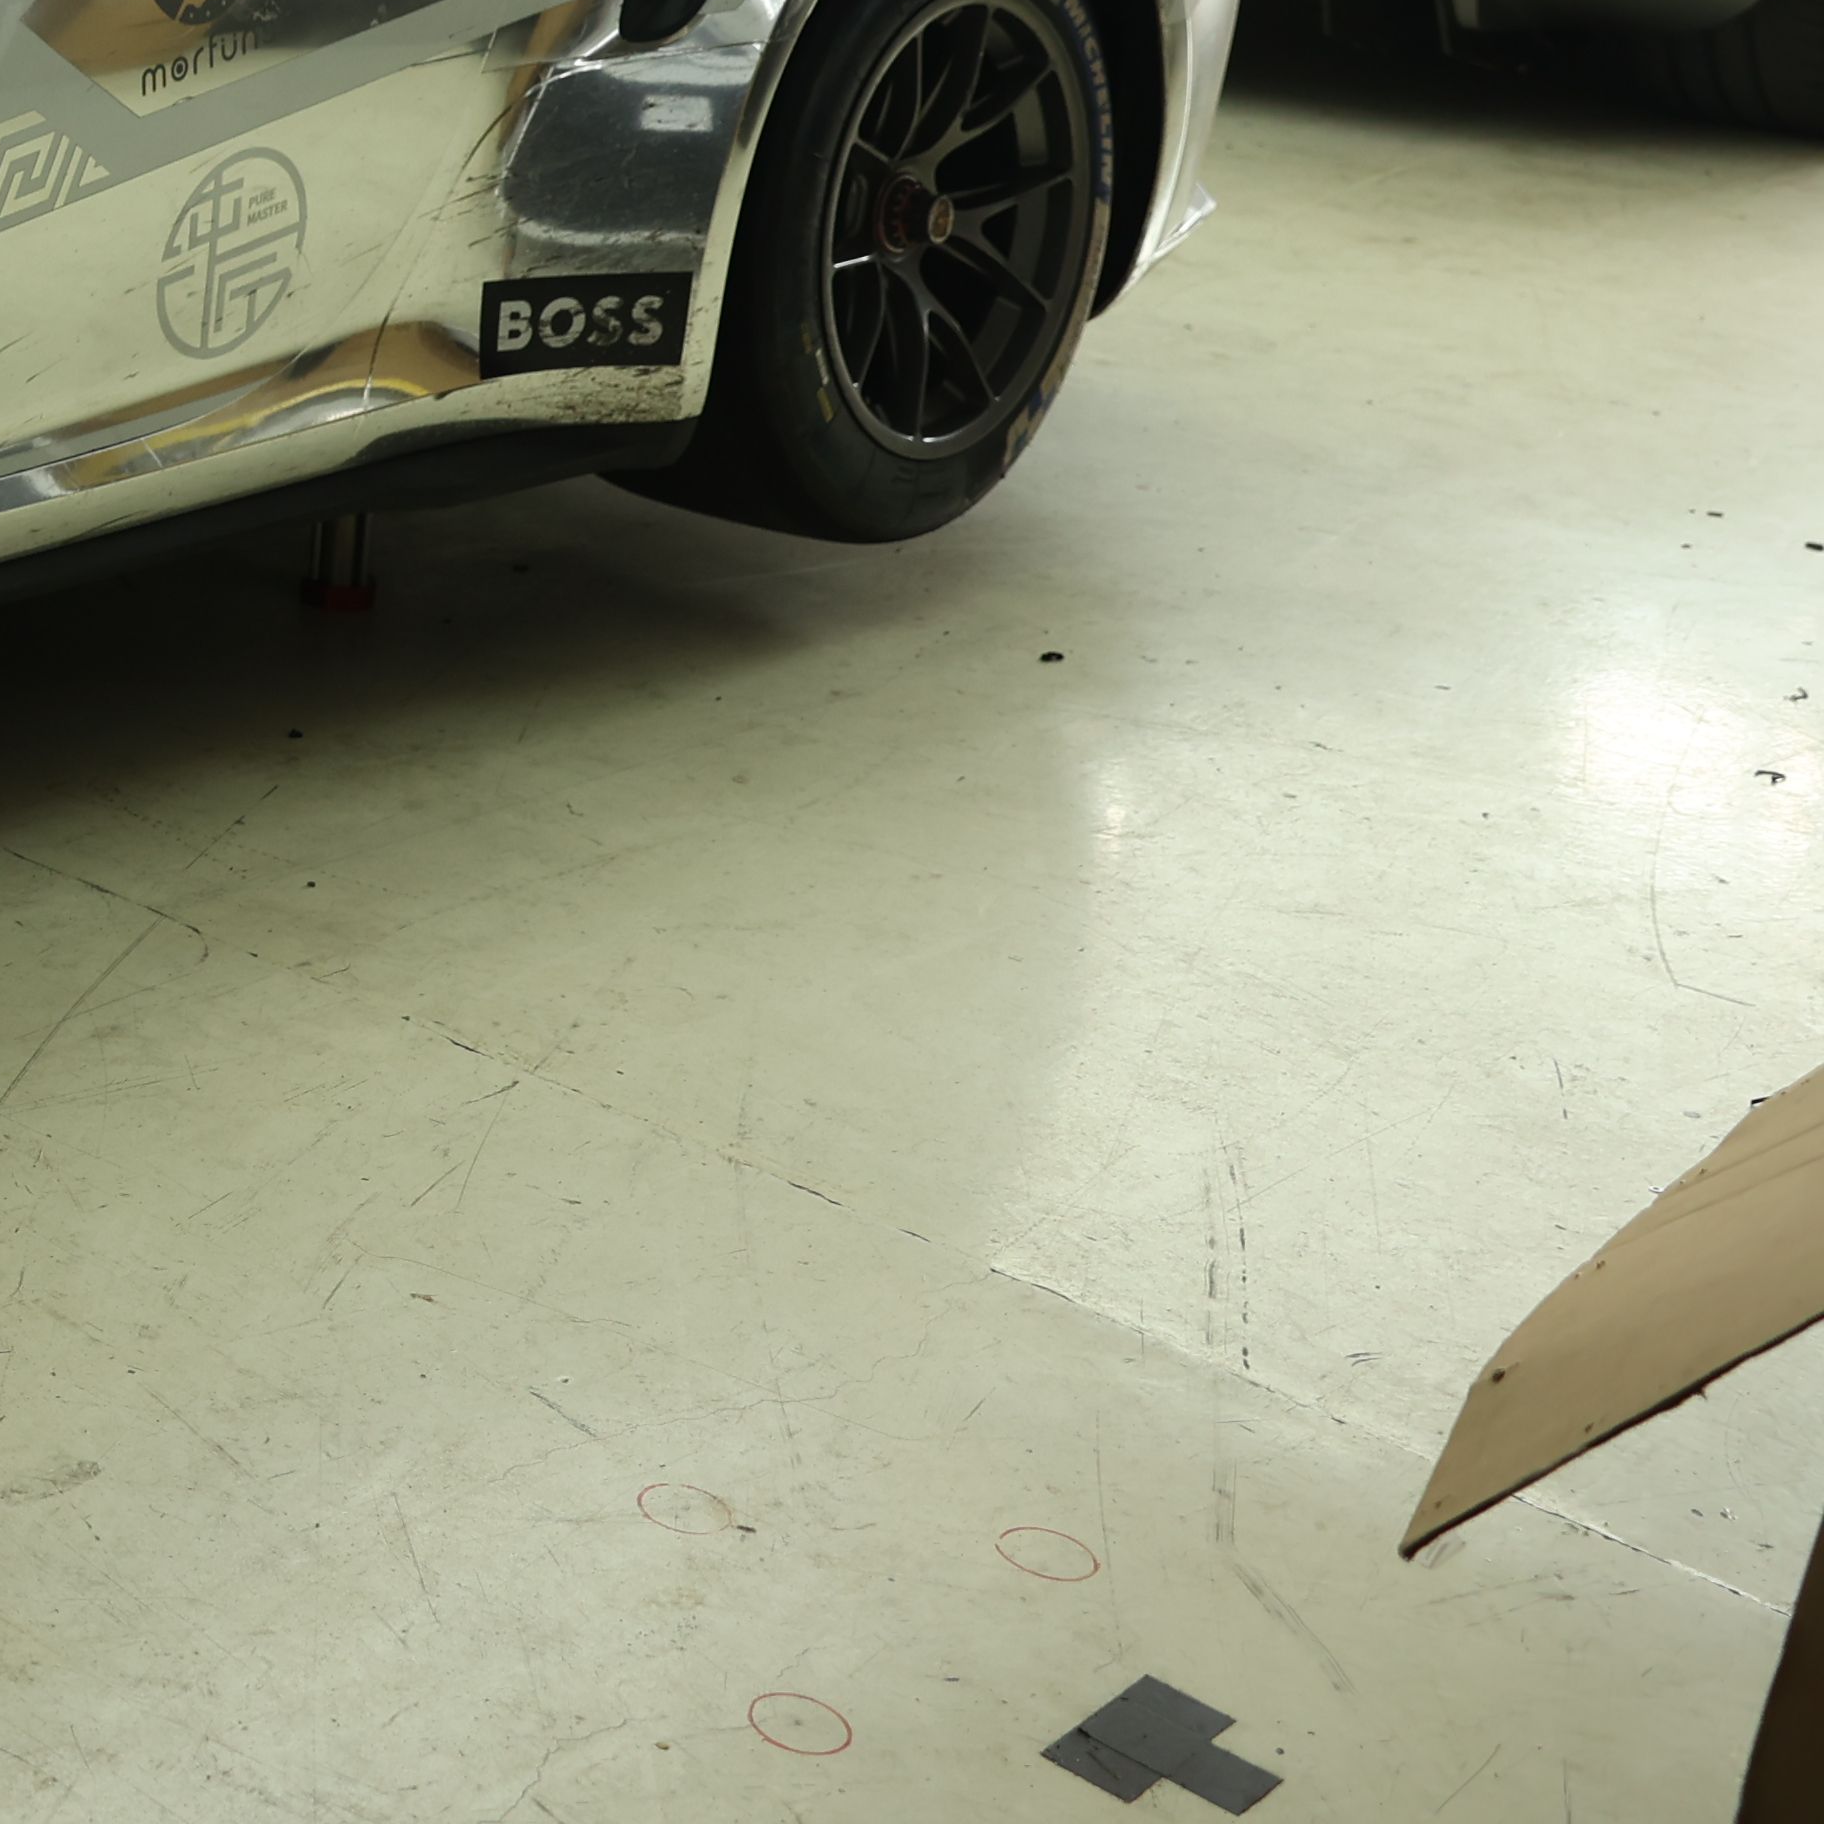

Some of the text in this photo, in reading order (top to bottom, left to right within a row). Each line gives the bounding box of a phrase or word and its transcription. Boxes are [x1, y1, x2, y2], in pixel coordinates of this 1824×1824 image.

[248, 187, 277, 209] PURE
[246, 199, 289, 227] MASTER
[496, 295, 664, 352] BOSS
